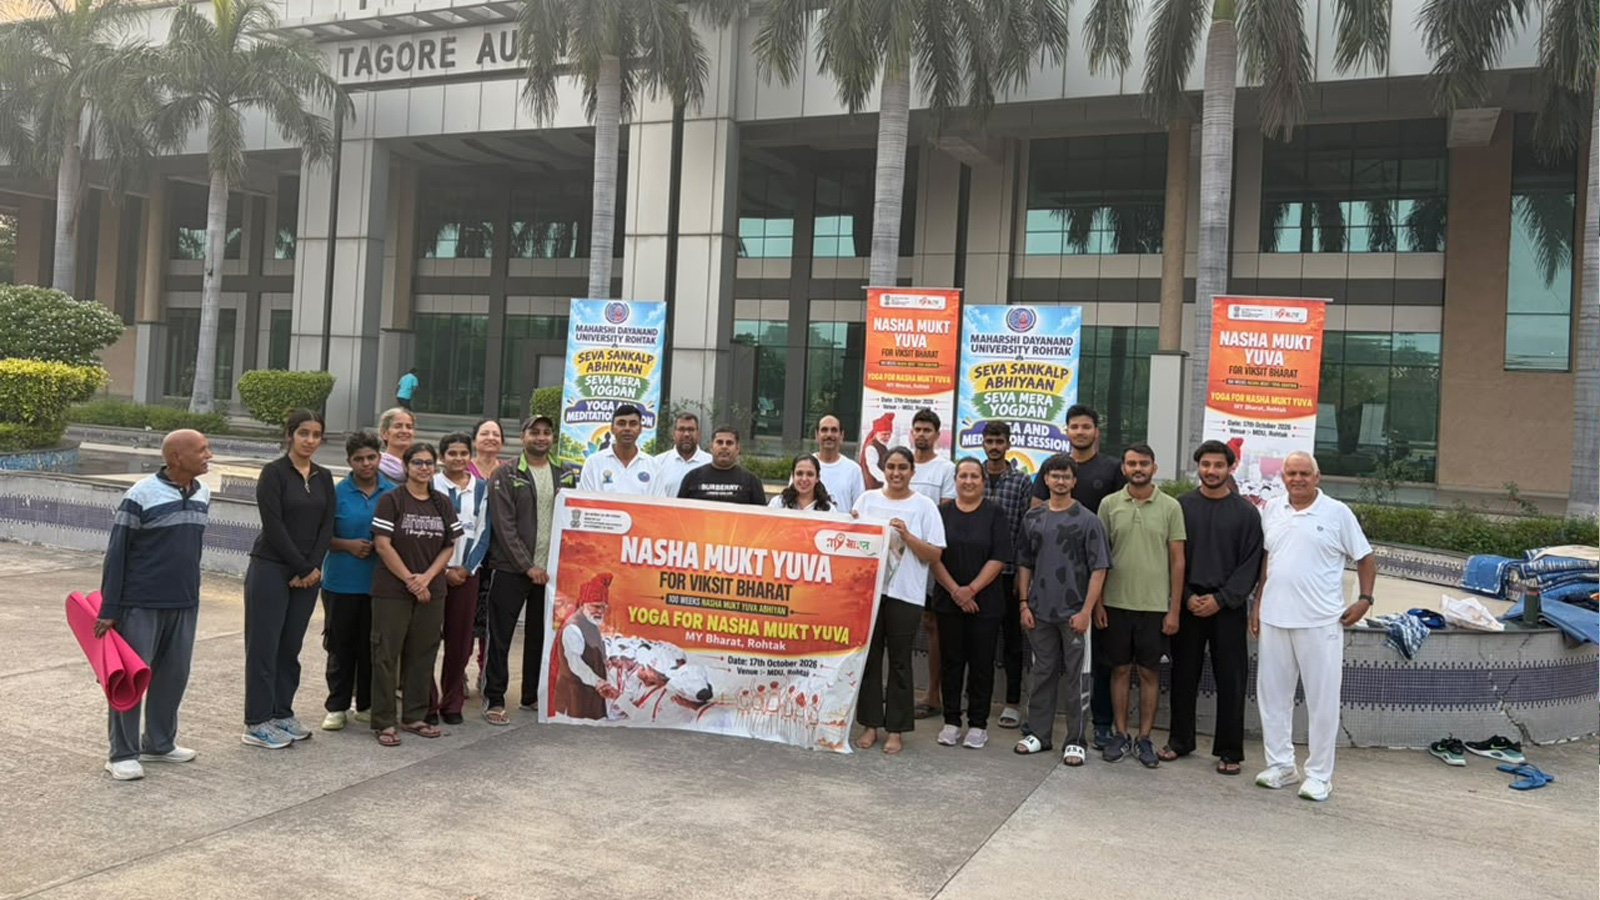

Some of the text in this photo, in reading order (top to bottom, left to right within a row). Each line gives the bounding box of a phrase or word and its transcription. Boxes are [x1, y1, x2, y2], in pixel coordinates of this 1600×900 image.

[340, 36, 456, 77] TAGORE
[576, 324, 658, 336] MAHARSHI DAYANAND
[874, 317, 950, 334] NASHA MUKT
[576, 333, 656, 345] UNIVERSITY ROHTAK
[894, 333, 927, 348] YUVA
[970, 335, 1073, 346] MAHARSHI DAYANAND
[1219, 331, 1313, 350] NASHA MUKT
[882, 348, 939, 358] FOR VIKSIT BHARAT
[971, 344, 1071, 356] UNIVERSITY ROHTAK
[578, 351, 654, 365] SEVA SANKALP
[1244, 349, 1285, 366] YUVA
[586, 361, 642, 374] ABHIYAAN
[975, 364, 1068, 379] SEVA SANKALP
[1229, 366, 1298, 378] FOR VIKSIT BHARAT
[585, 375, 641, 388] SEVA MERA
[868, 372, 883, 381] YOGA
[884, 373, 895, 381] FOR
[896, 374, 916, 382] NASHA
[985, 377, 1055, 391] ABHIYAAN
[589, 385, 636, 398] YOGDAN
[586, 401, 614, 411] YOGA
[984, 393, 1053, 407] SEVA MERA
[1211, 392, 1312, 407] YOGA FOR NASHA MUKT YUVA
[567, 411, 613, 422] MEDITATIO
[989, 404, 1047, 418] YOGDAN
[1024, 423, 1049, 436] AND
[1027, 437, 1070, 453] SESSION
[620, 536, 832, 584] NASHA MUKT YUVA
[659, 572, 793, 601] FOR VIKSIT BHARAT
[669, 595, 786, 615] 100 WEEKS NASHA MUKT YUVA ABHIYAN
[628, 607, 850, 645] YOGA FOR NASHA MUKT YUVA
[685, 632, 786, 651] MY Bharat, Rohtak
[728, 656, 818, 669] Date: 17th October 2026
